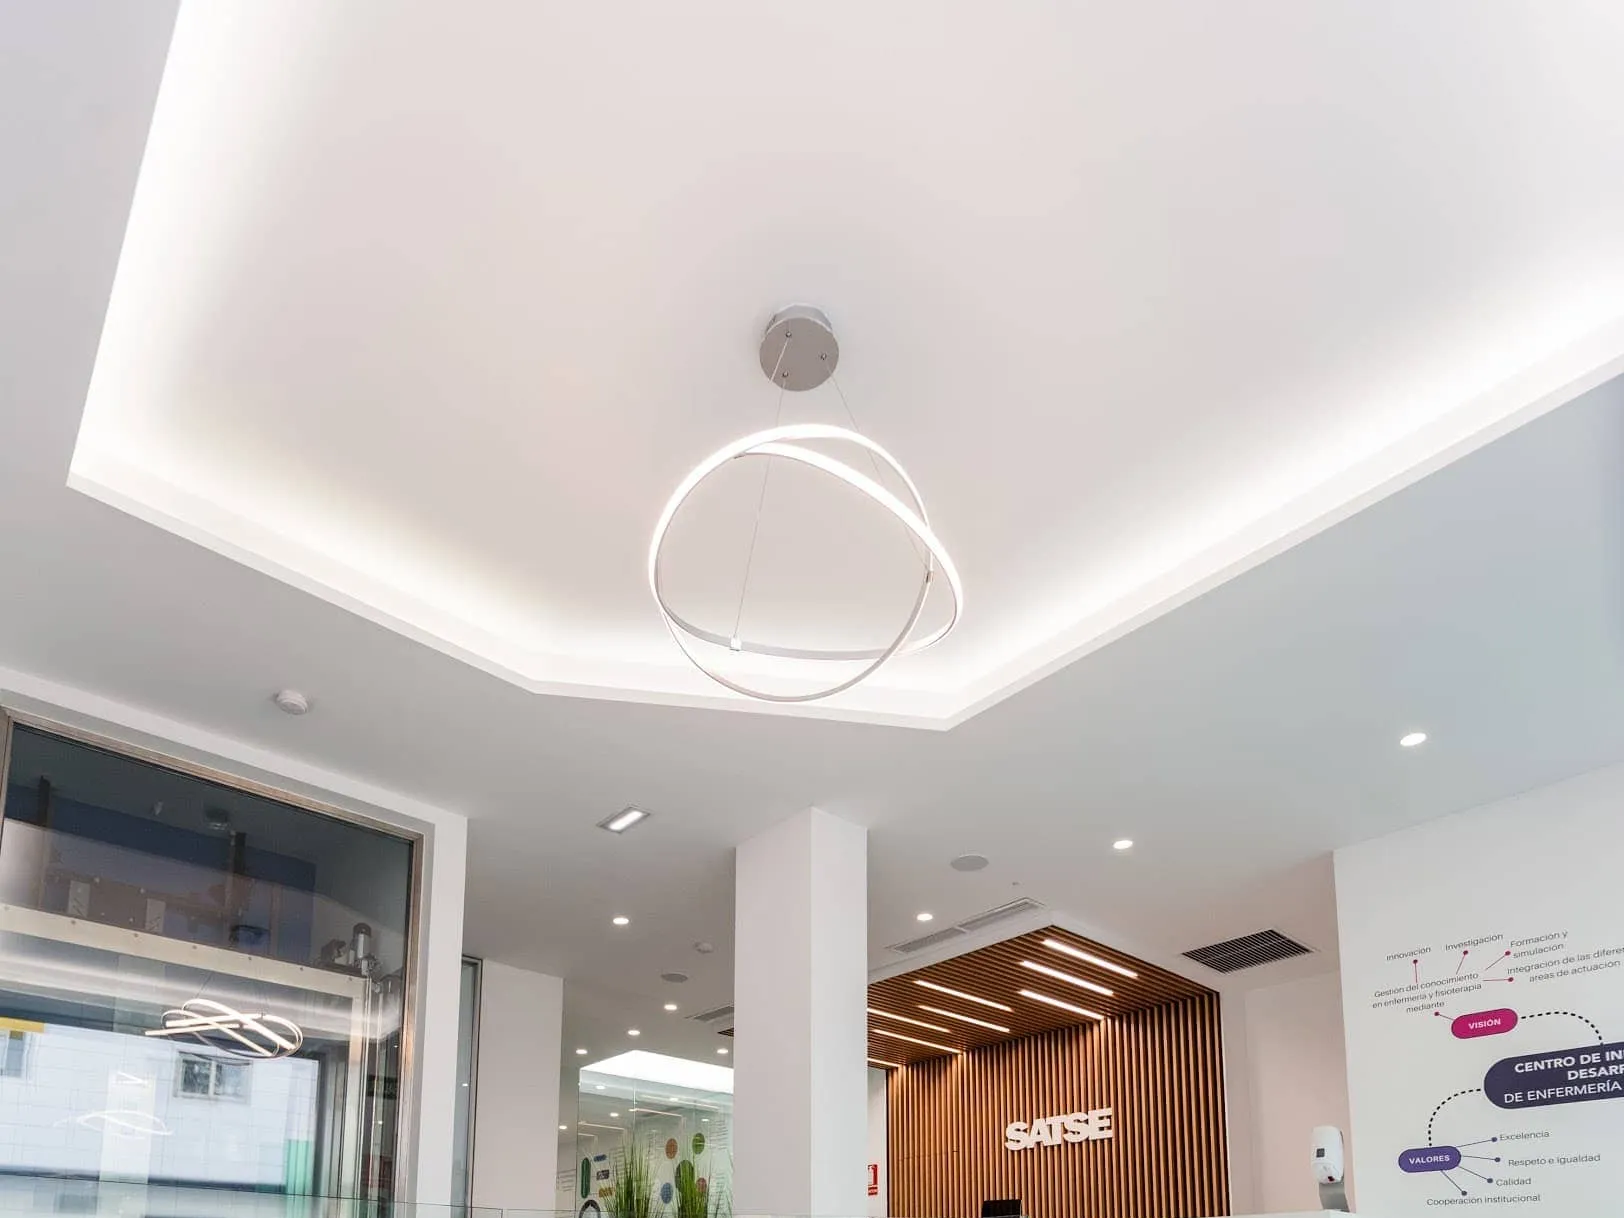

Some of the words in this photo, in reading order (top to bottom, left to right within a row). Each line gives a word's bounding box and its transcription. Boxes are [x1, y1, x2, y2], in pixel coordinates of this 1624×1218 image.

[1562, 956, 1575, 965] de
[1577, 953, 1591, 961] las
[1556, 967, 1569, 977] de
[1406, 984, 1419, 993] del
[1420, 972, 1479, 990] conocimiento
[1372, 1001, 1383, 1009] en
[1435, 982, 1482, 998] fisioterapia
[1406, 1000, 1445, 1014] mediante
[1514, 1056, 1575, 1073] CENTRO
[1580, 1053, 1601, 1064] DE
[1605, 1049, 1624, 1061] IN
[1504, 1092, 1524, 1103] DE
[1527, 1079, 1622, 1101] ENFERMERÍA
[1004, 1107, 1114, 1151] SATSE
[1500, 1130, 1550, 1141] Excelencia
[1408, 1154, 1451, 1165] VALORES
[1508, 1158, 1546, 1168] Respeto
[1557, 1153, 1601, 1165] igualdad
[1496, 1177, 1531, 1187] Calidad
[1484, 1194, 1541, 1203] institucional
